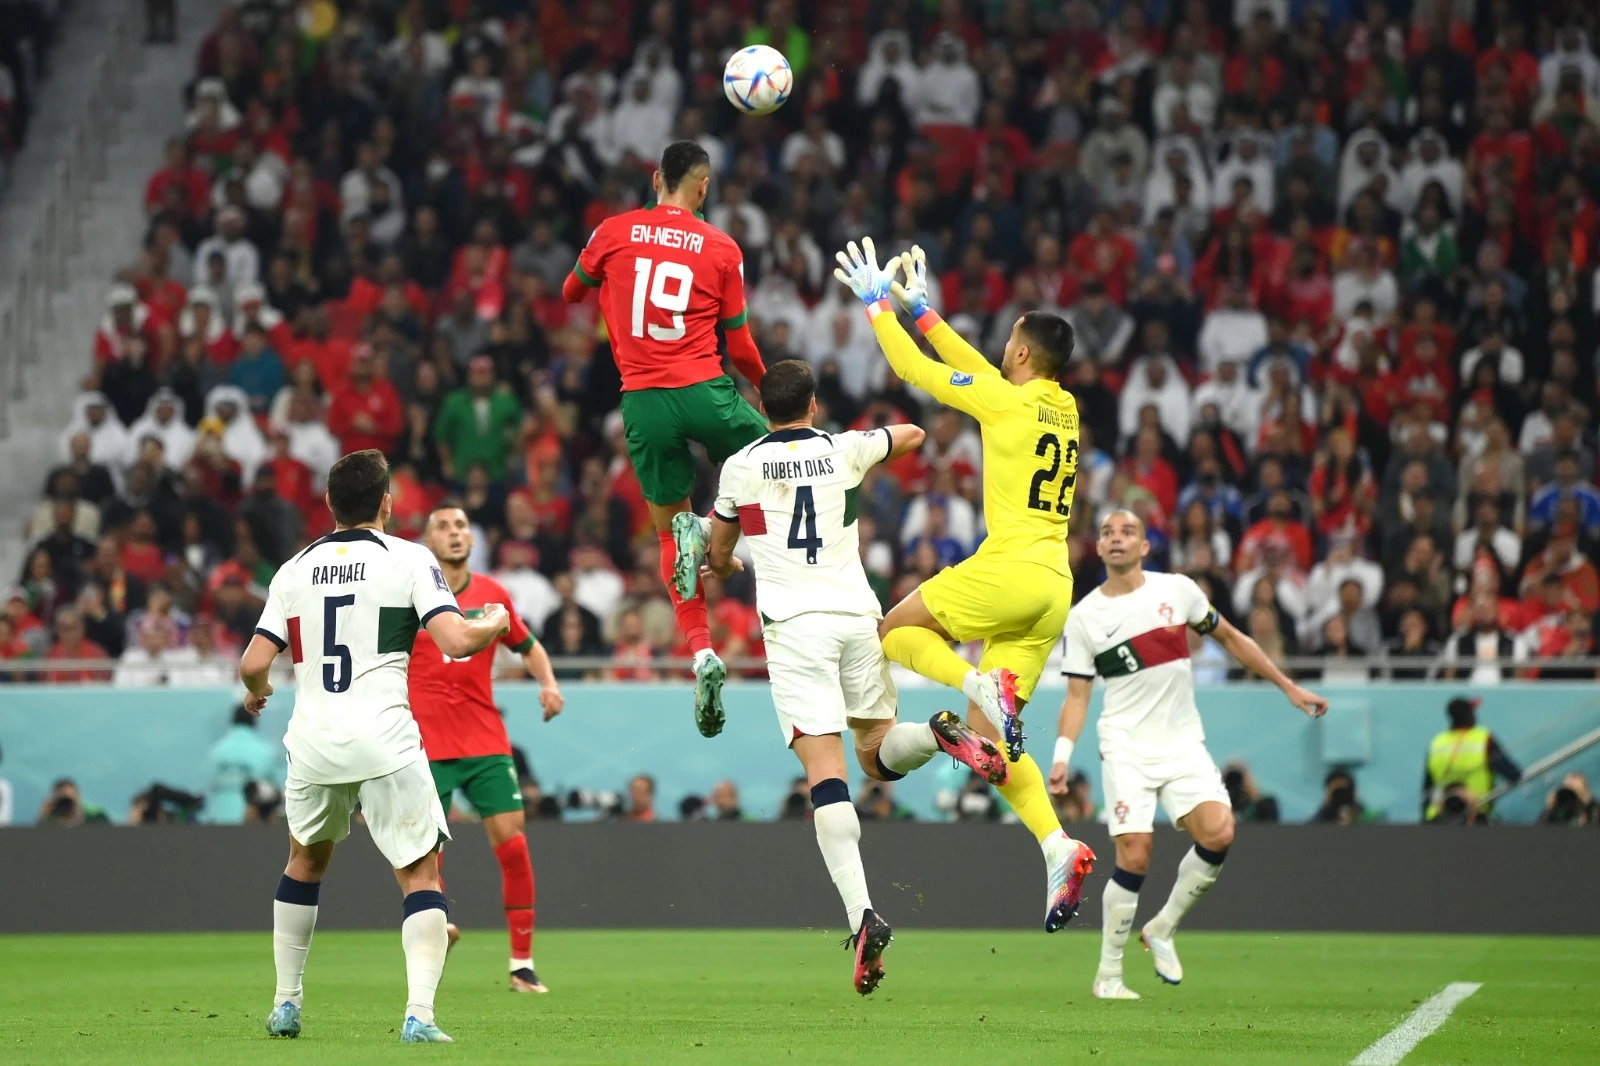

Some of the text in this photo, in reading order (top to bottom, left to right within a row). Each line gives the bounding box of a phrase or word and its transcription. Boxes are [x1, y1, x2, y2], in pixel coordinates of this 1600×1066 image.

[631, 225, 704, 254] EN-NESYRI
[631, 256, 694, 341] 19
[1060, 412, 1079, 430] COST
[805, 458, 834, 477] DIAS
[1028, 433, 1079, 516] 22
[788, 485, 823, 564] 4
[312, 562, 366, 586] RAPHAEL
[322, 593, 355, 693] 5
[1117, 645, 1139, 672] 3
